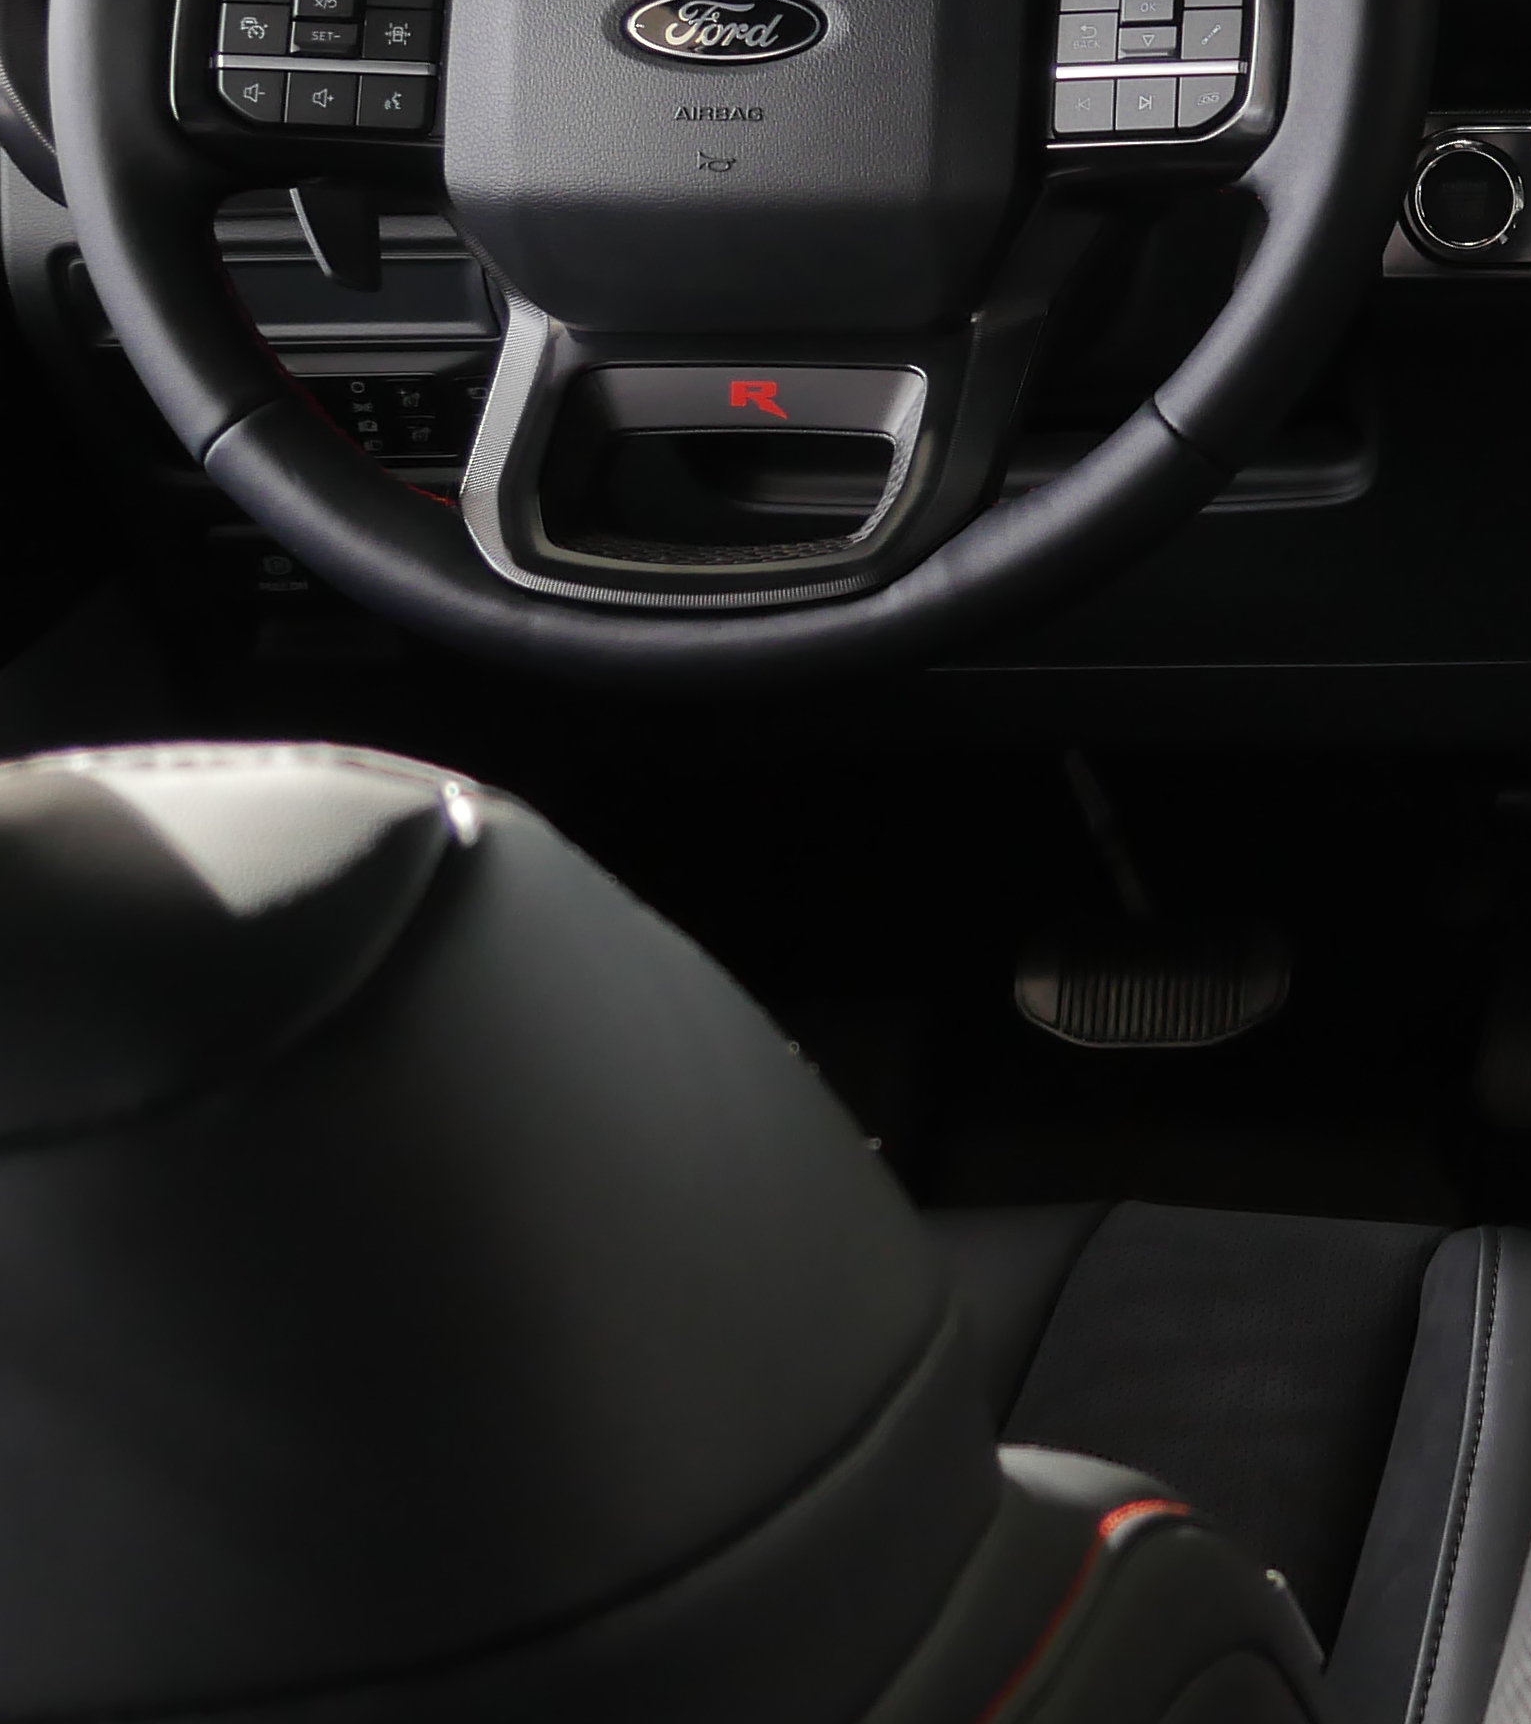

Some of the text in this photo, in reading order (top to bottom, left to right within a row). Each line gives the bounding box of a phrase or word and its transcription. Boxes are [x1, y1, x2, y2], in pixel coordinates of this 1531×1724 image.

[1140, 2, 1156, 13] OK
[664, 1, 779, 49] Ford
[1072, 38, 1101, 50] BACK
[674, 106, 763, 122] AIRBAG
